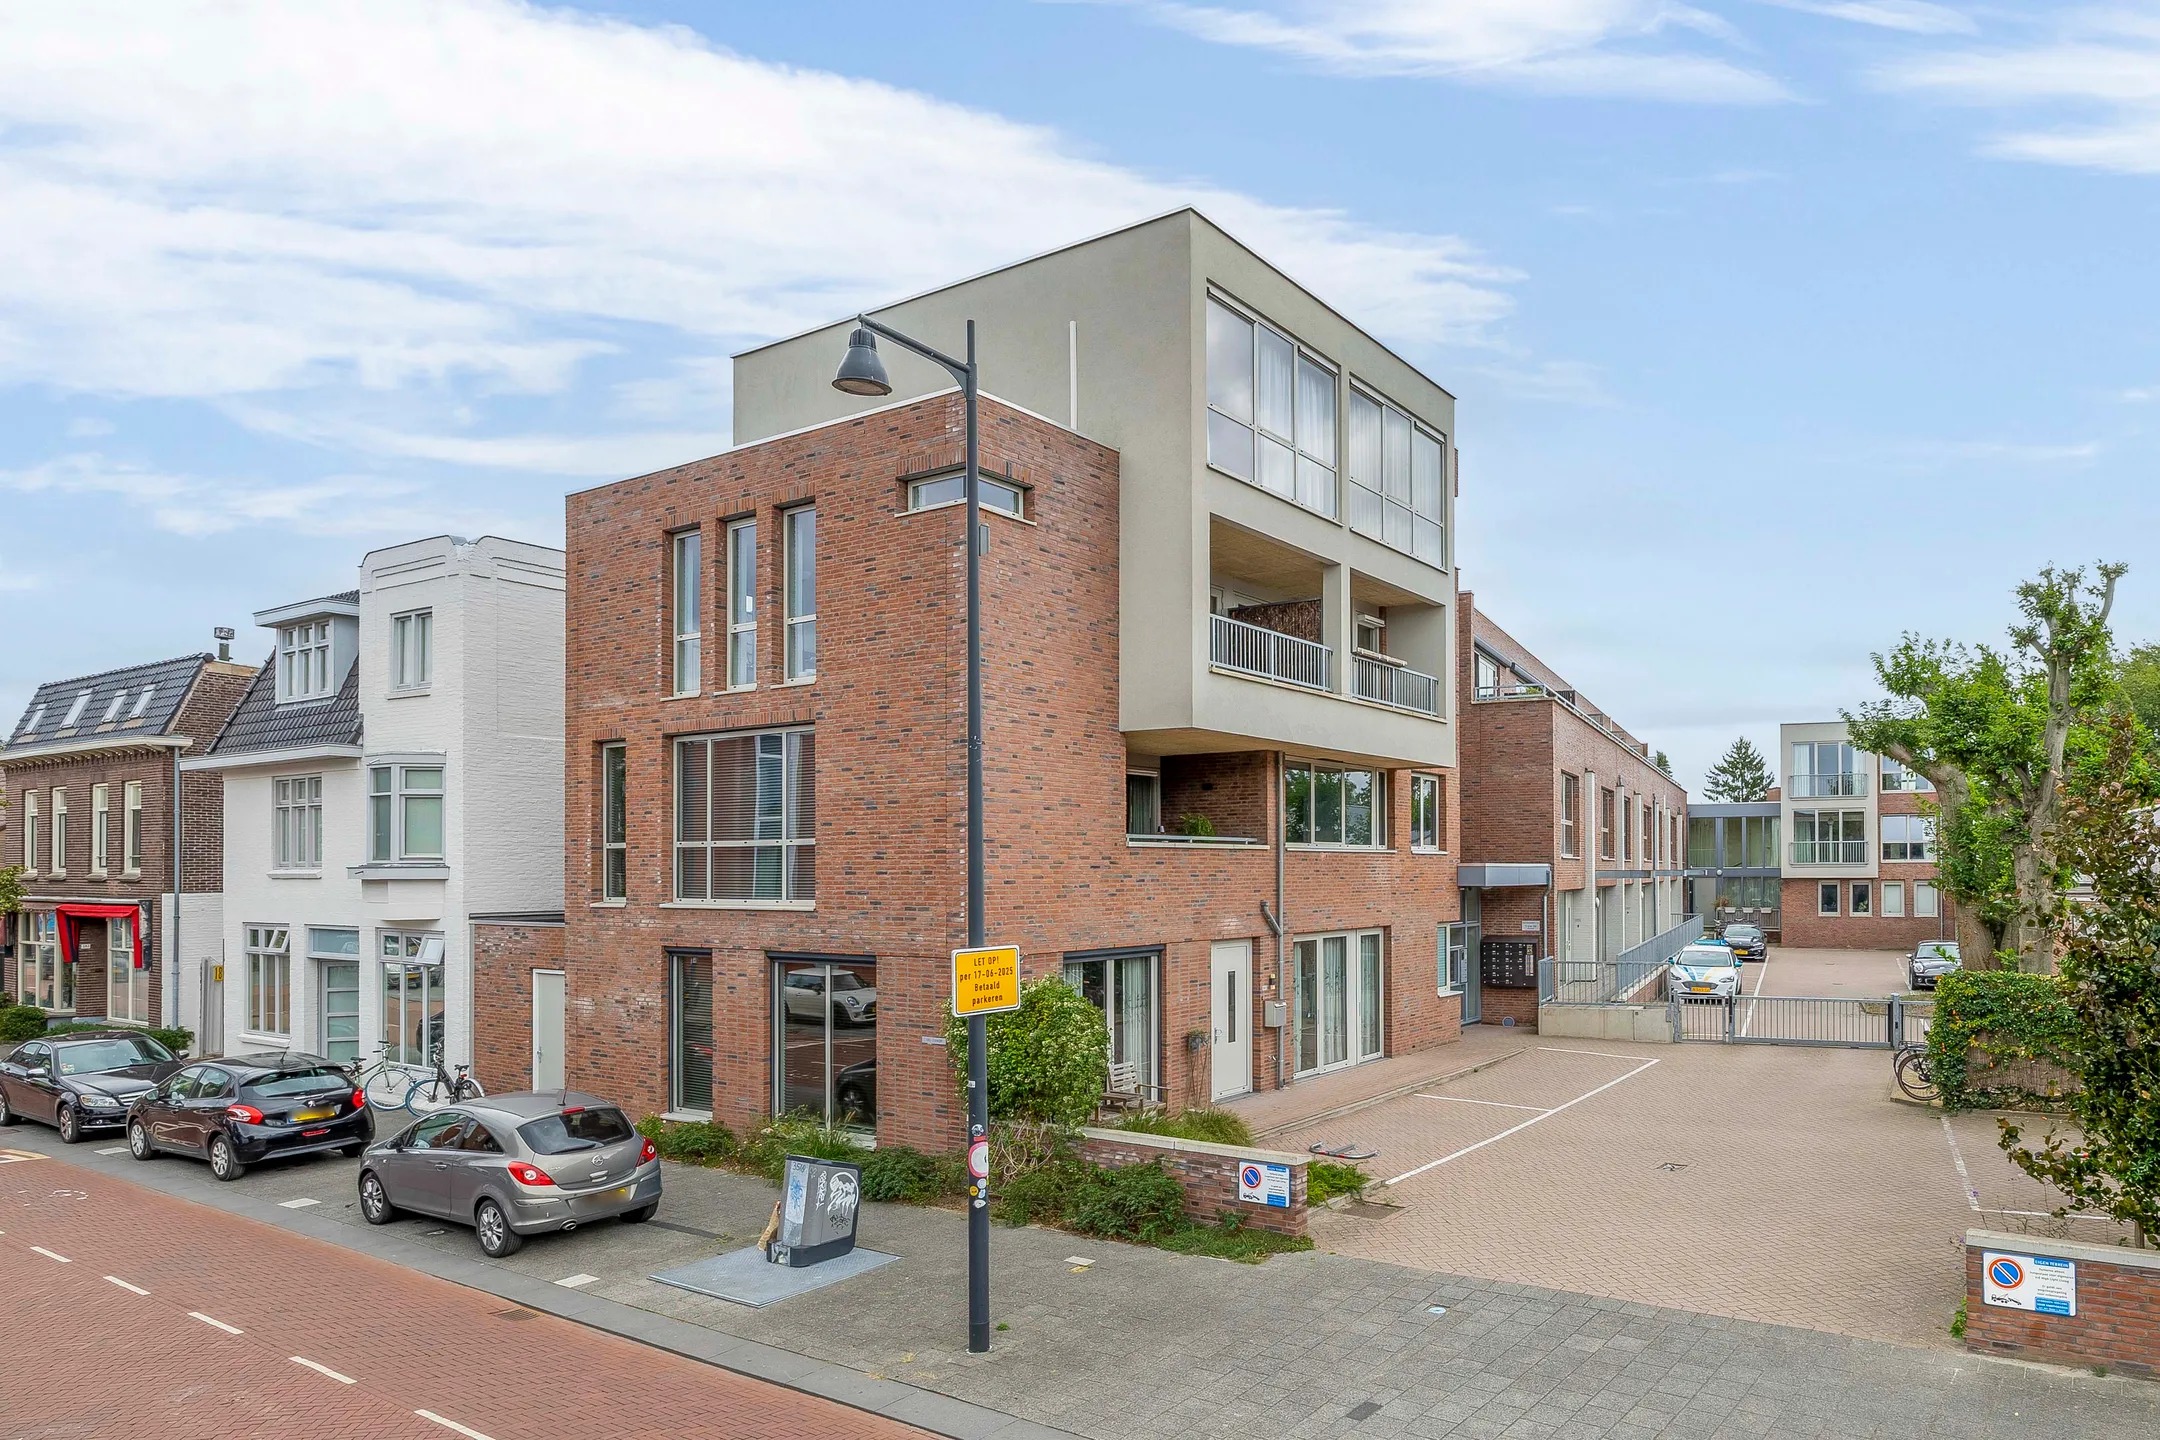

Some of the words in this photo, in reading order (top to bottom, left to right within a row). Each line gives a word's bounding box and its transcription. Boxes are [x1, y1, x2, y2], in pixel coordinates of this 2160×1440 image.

[974, 957, 985, 966] LET
[988, 956, 999, 965] OP!
[960, 972, 971, 983] per
[974, 966, 1013, 979] 17-06-2025
[974, 981, 1000, 991] Betaald
[972, 994, 1003, 1006] parkeren
